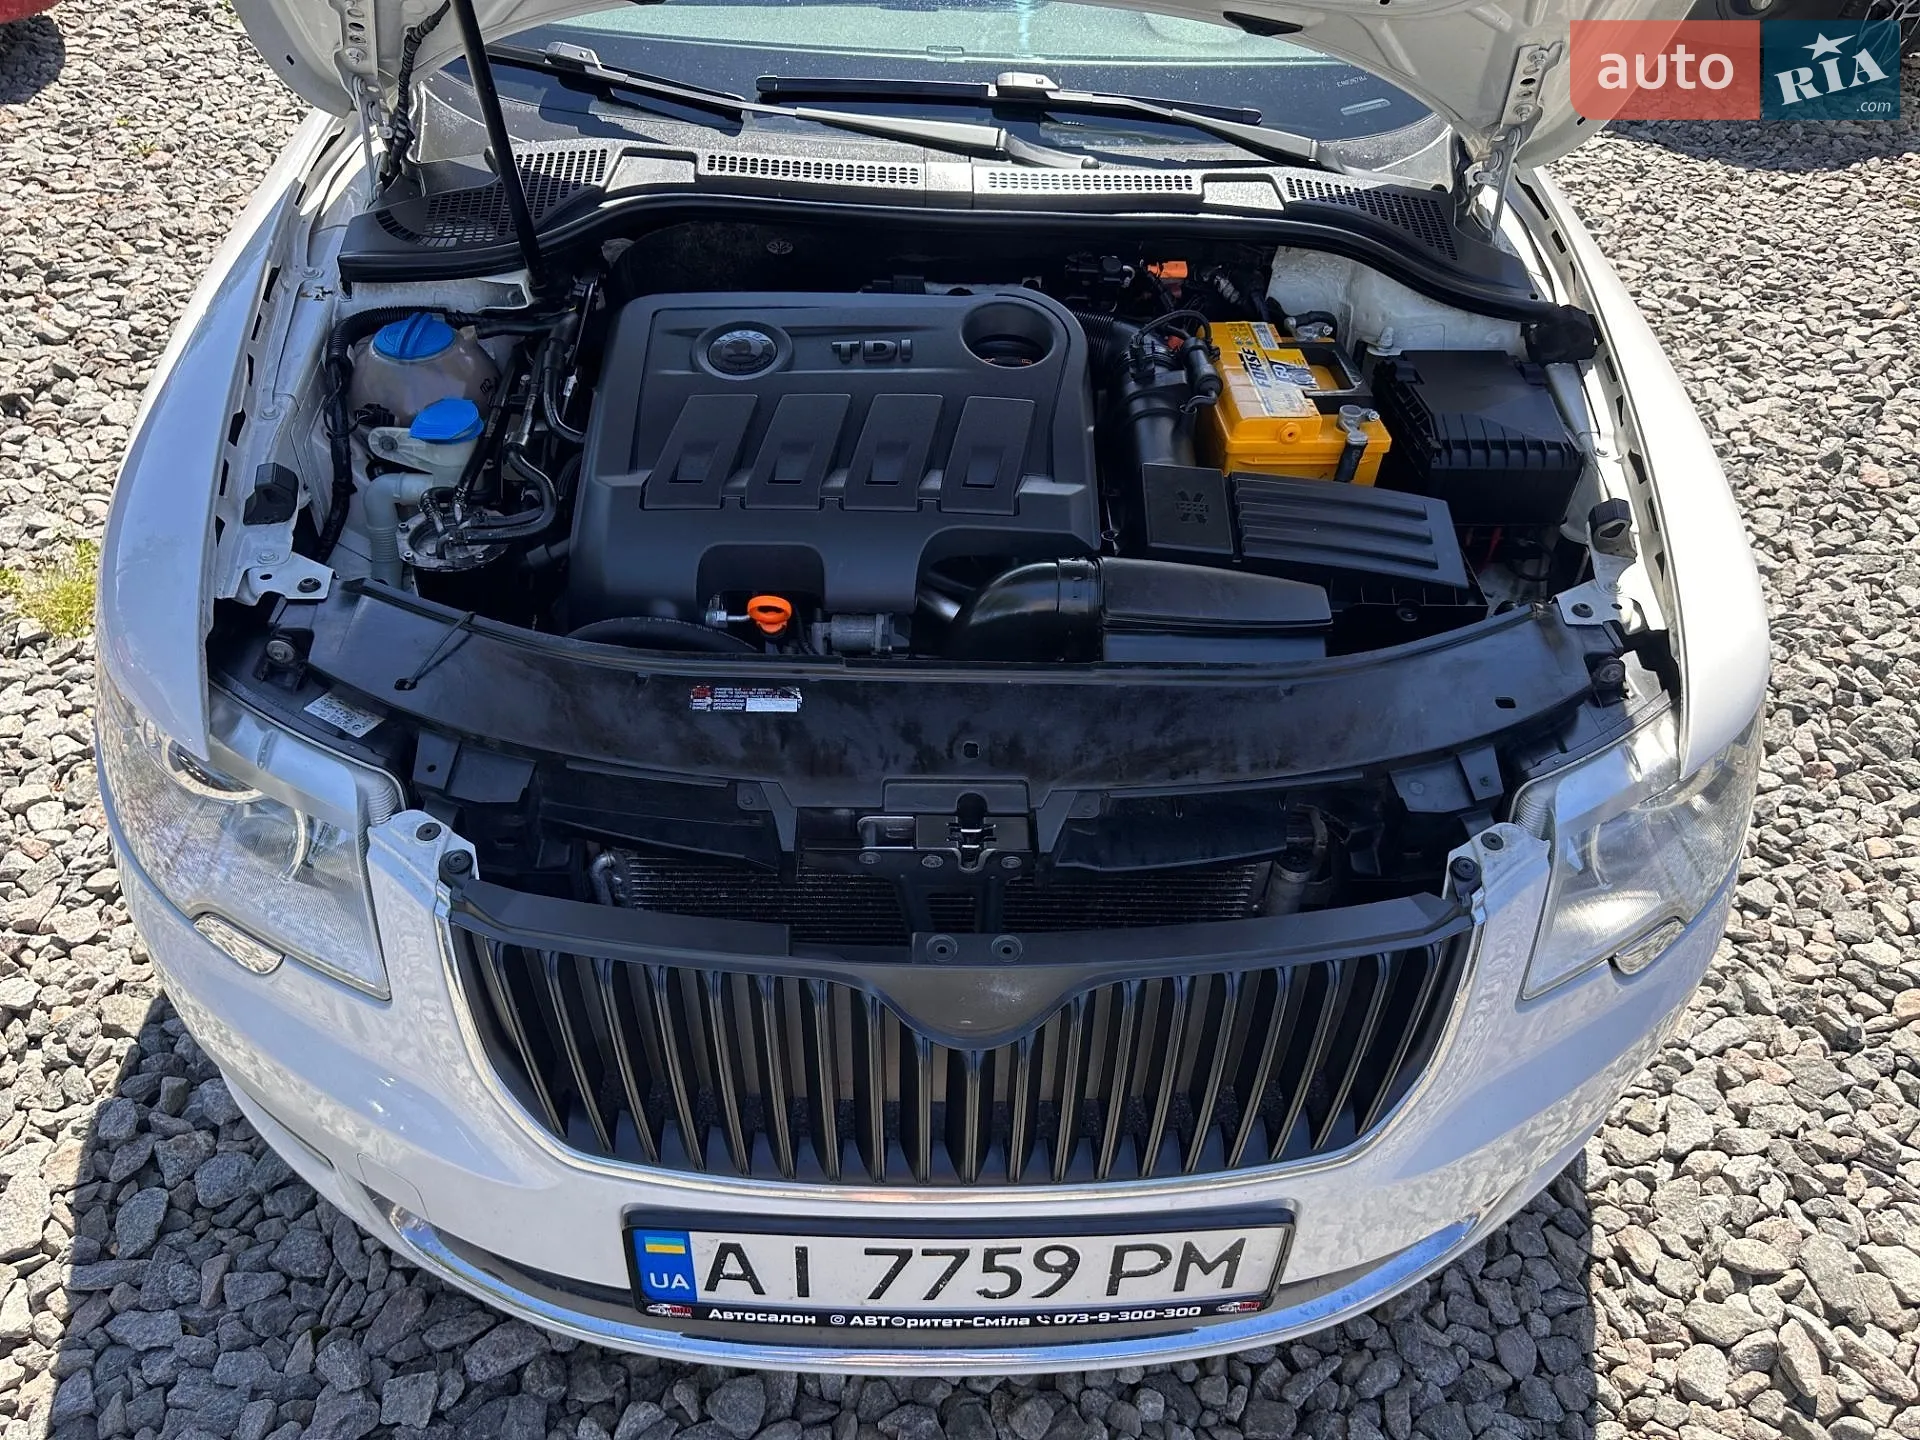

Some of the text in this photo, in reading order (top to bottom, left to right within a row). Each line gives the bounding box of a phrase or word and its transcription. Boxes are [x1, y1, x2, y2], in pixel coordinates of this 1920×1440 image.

[831, 338, 913, 363] TDI
[864, 1243, 1081, 1300] 7759
[1105, 1237, 1247, 1297] PM
[649, 1272, 690, 1291] UA
[708, 1308, 817, 1325] Автосалон
[1053, 1306, 1202, 1325] 073-9-300-300
